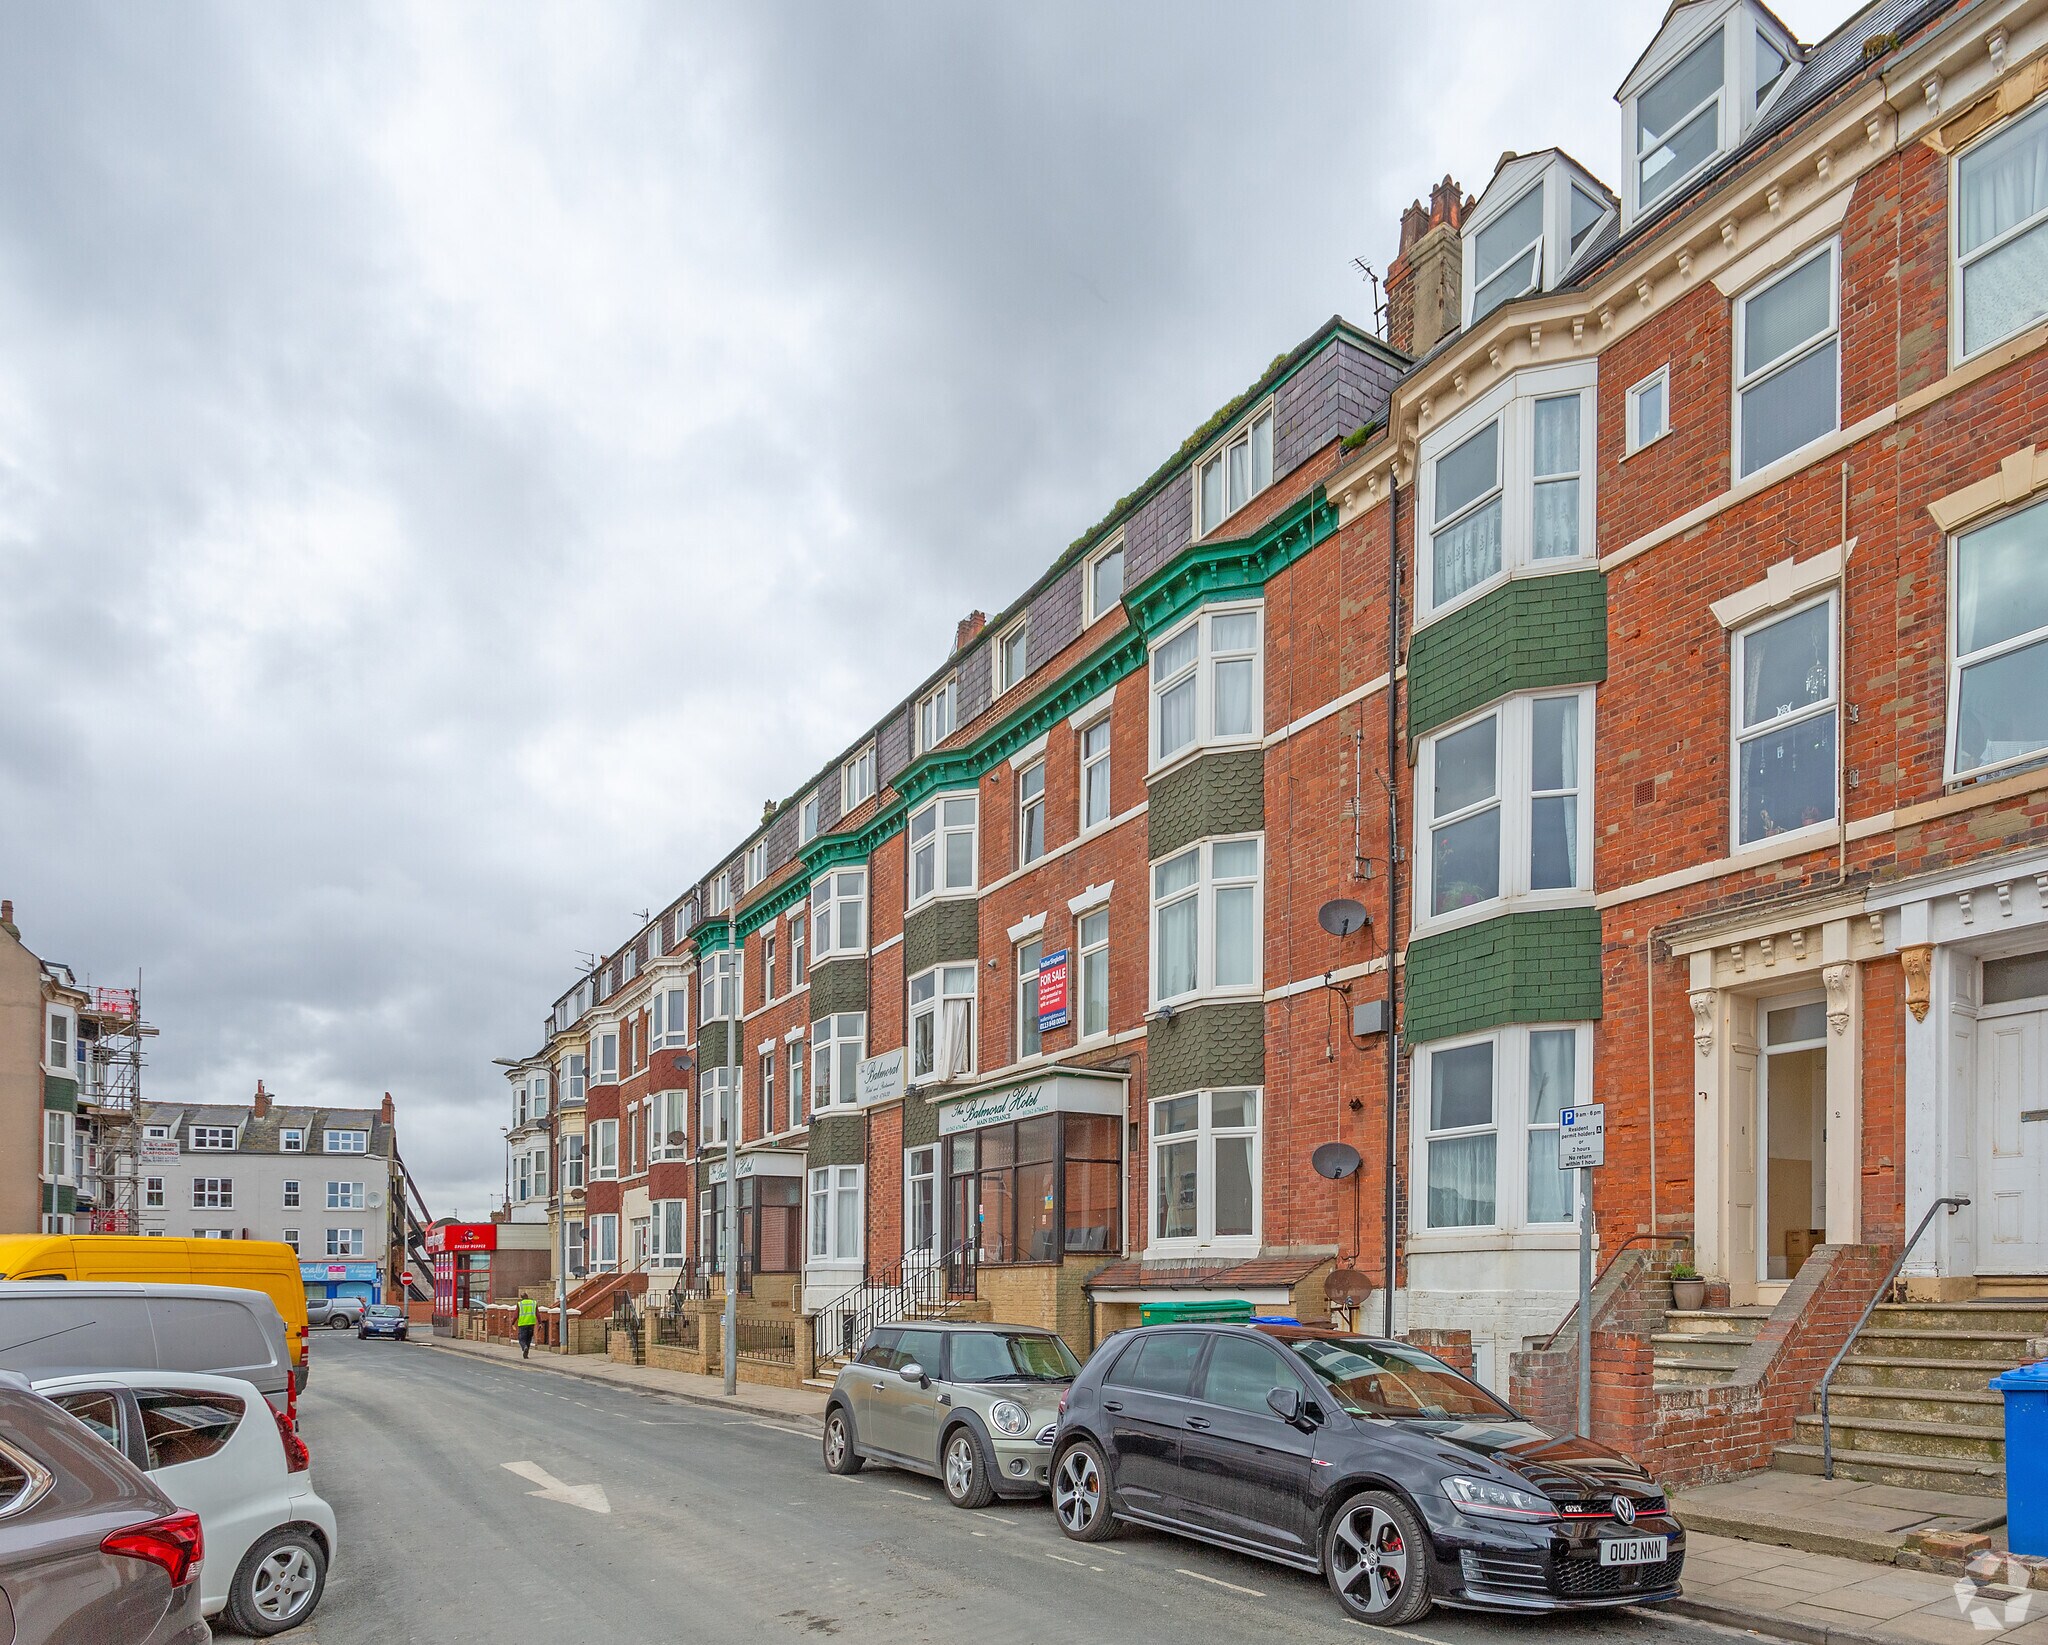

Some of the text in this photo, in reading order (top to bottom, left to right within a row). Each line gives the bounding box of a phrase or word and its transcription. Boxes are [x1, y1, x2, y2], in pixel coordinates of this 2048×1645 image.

[1040, 967, 1066, 987] FOR SALE
[864, 1056, 902, 1084] Balmoral
[951, 1086, 1042, 1122] The Balmoral Hotel
[976, 1113, 1011, 1126] MAIN ENTRANCE
[738, 1157, 754, 1176] Hotel
[1610, 1540, 1661, 1561] OU13 NNN
